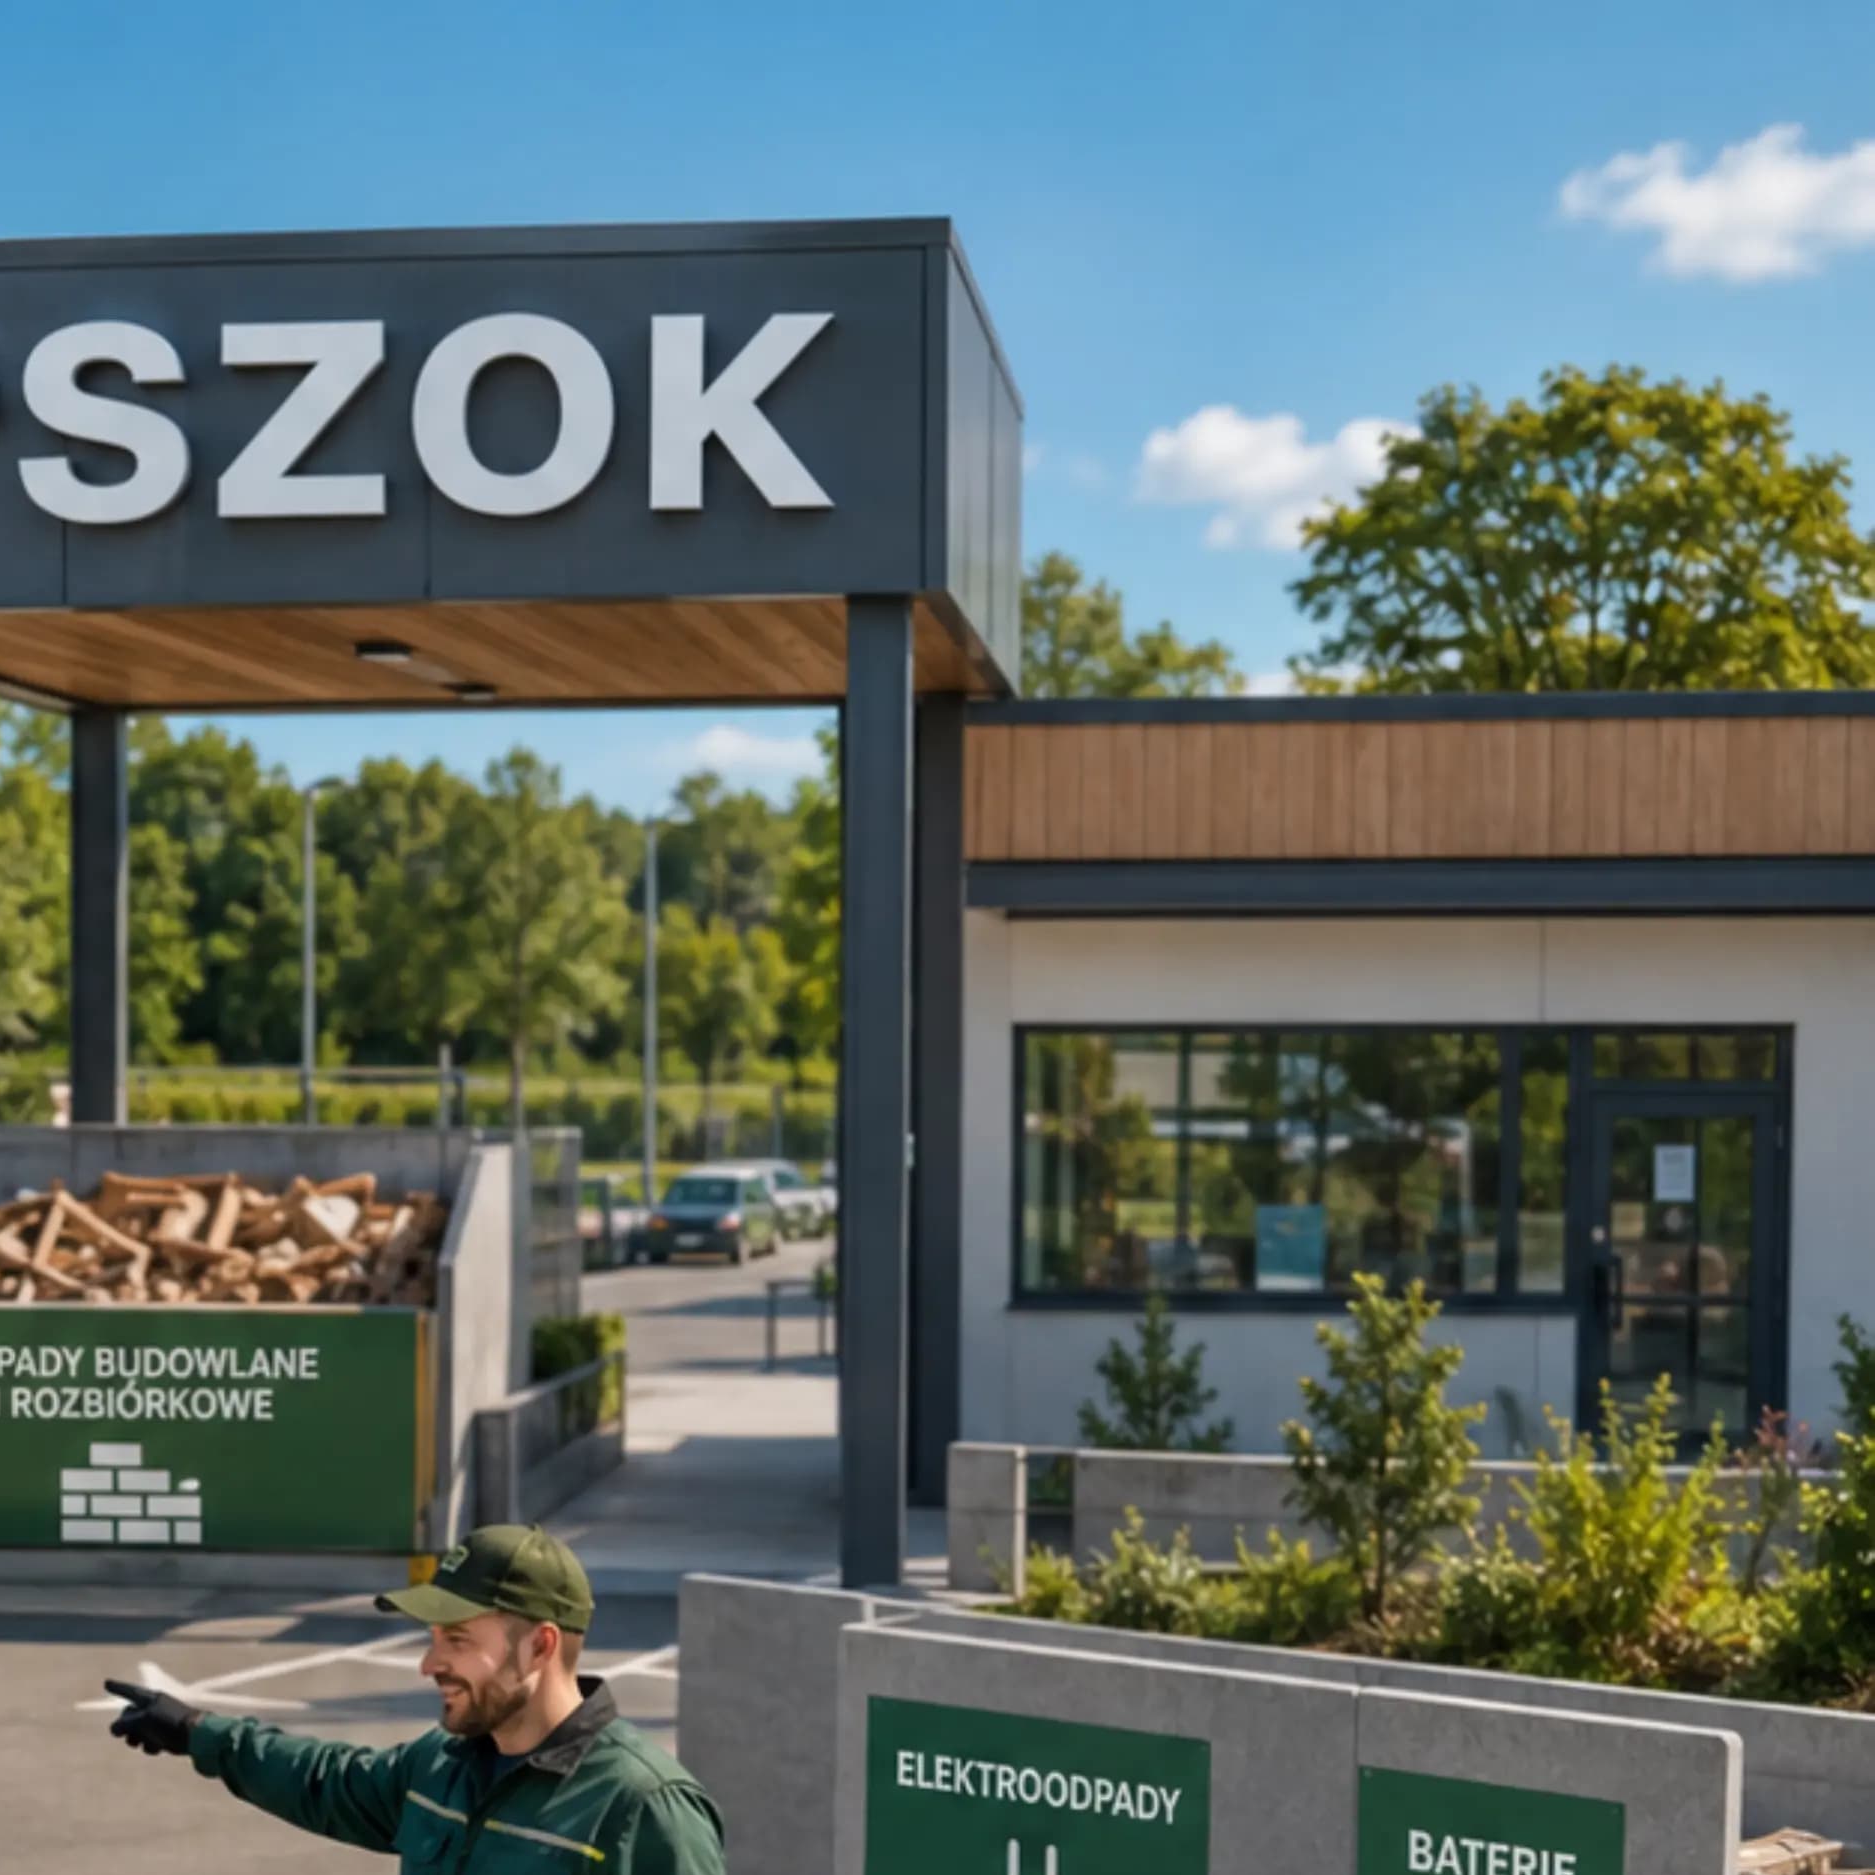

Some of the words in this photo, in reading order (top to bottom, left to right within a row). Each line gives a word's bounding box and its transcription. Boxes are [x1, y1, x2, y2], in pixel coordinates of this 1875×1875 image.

[94, 1347, 320, 1380] BUDOWLANE
[10, 1379, 274, 1420] ROZBIÓRKOWE
[896, 1750, 1182, 1825] ELEKTROODPADY
